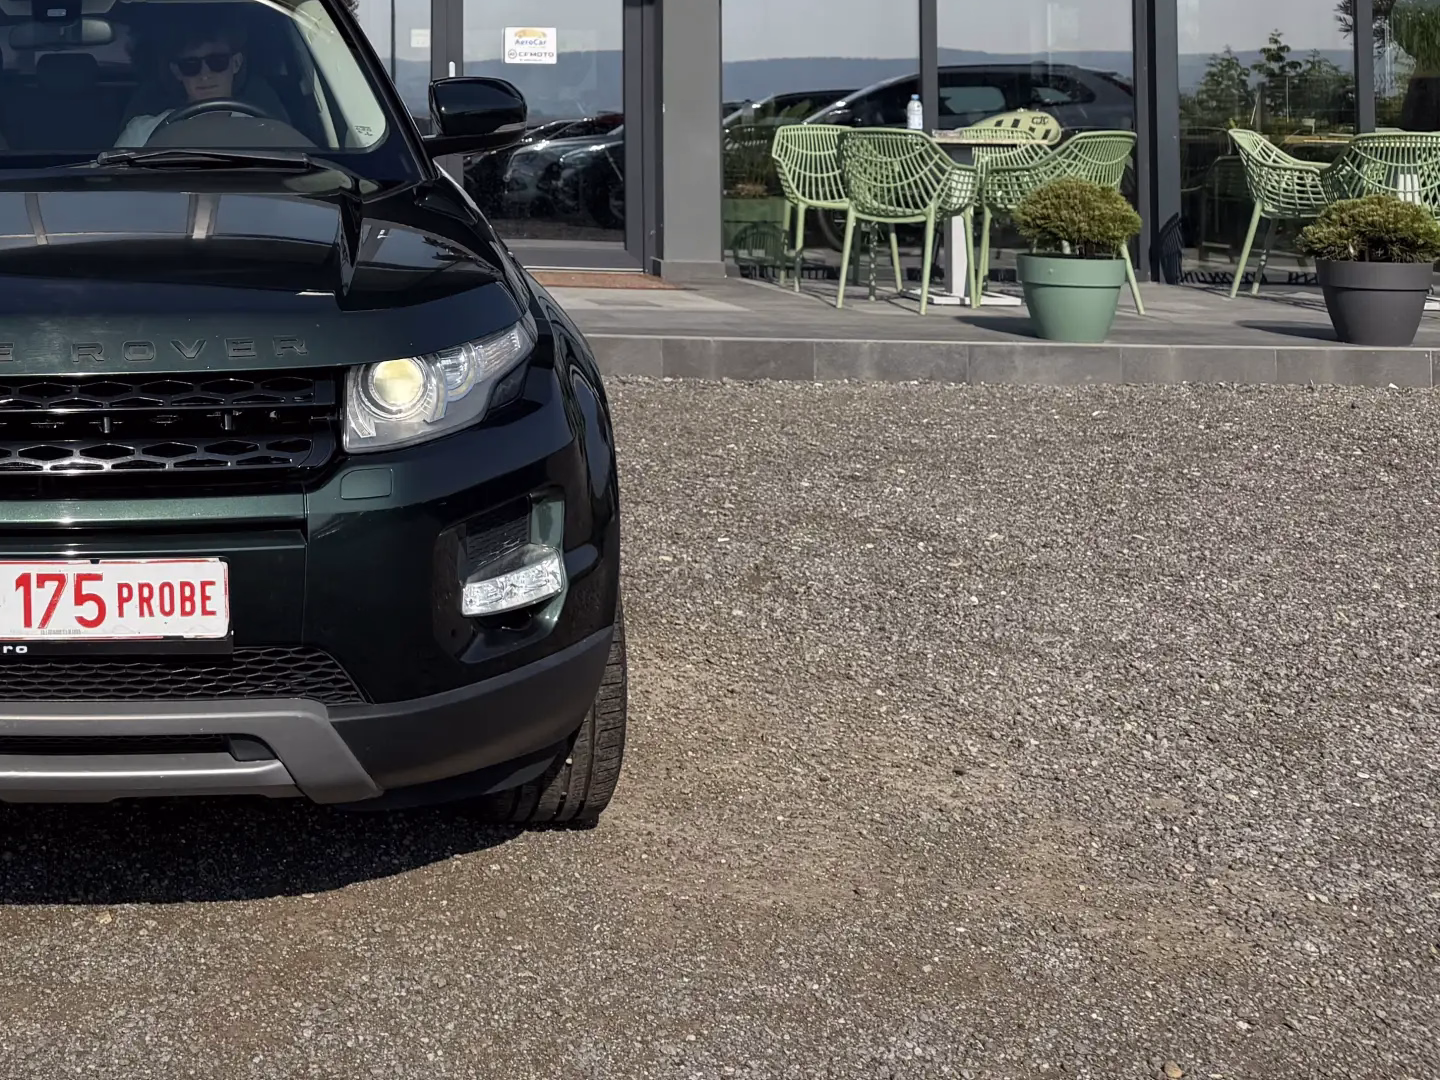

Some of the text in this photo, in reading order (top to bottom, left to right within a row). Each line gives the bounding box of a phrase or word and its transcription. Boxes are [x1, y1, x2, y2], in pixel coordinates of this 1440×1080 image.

[515, 38, 546, 46] AeroCar
[72, 335, 309, 364] ROVER
[14, 572, 107, 630] 175
[117, 580, 217, 618] PROBE
